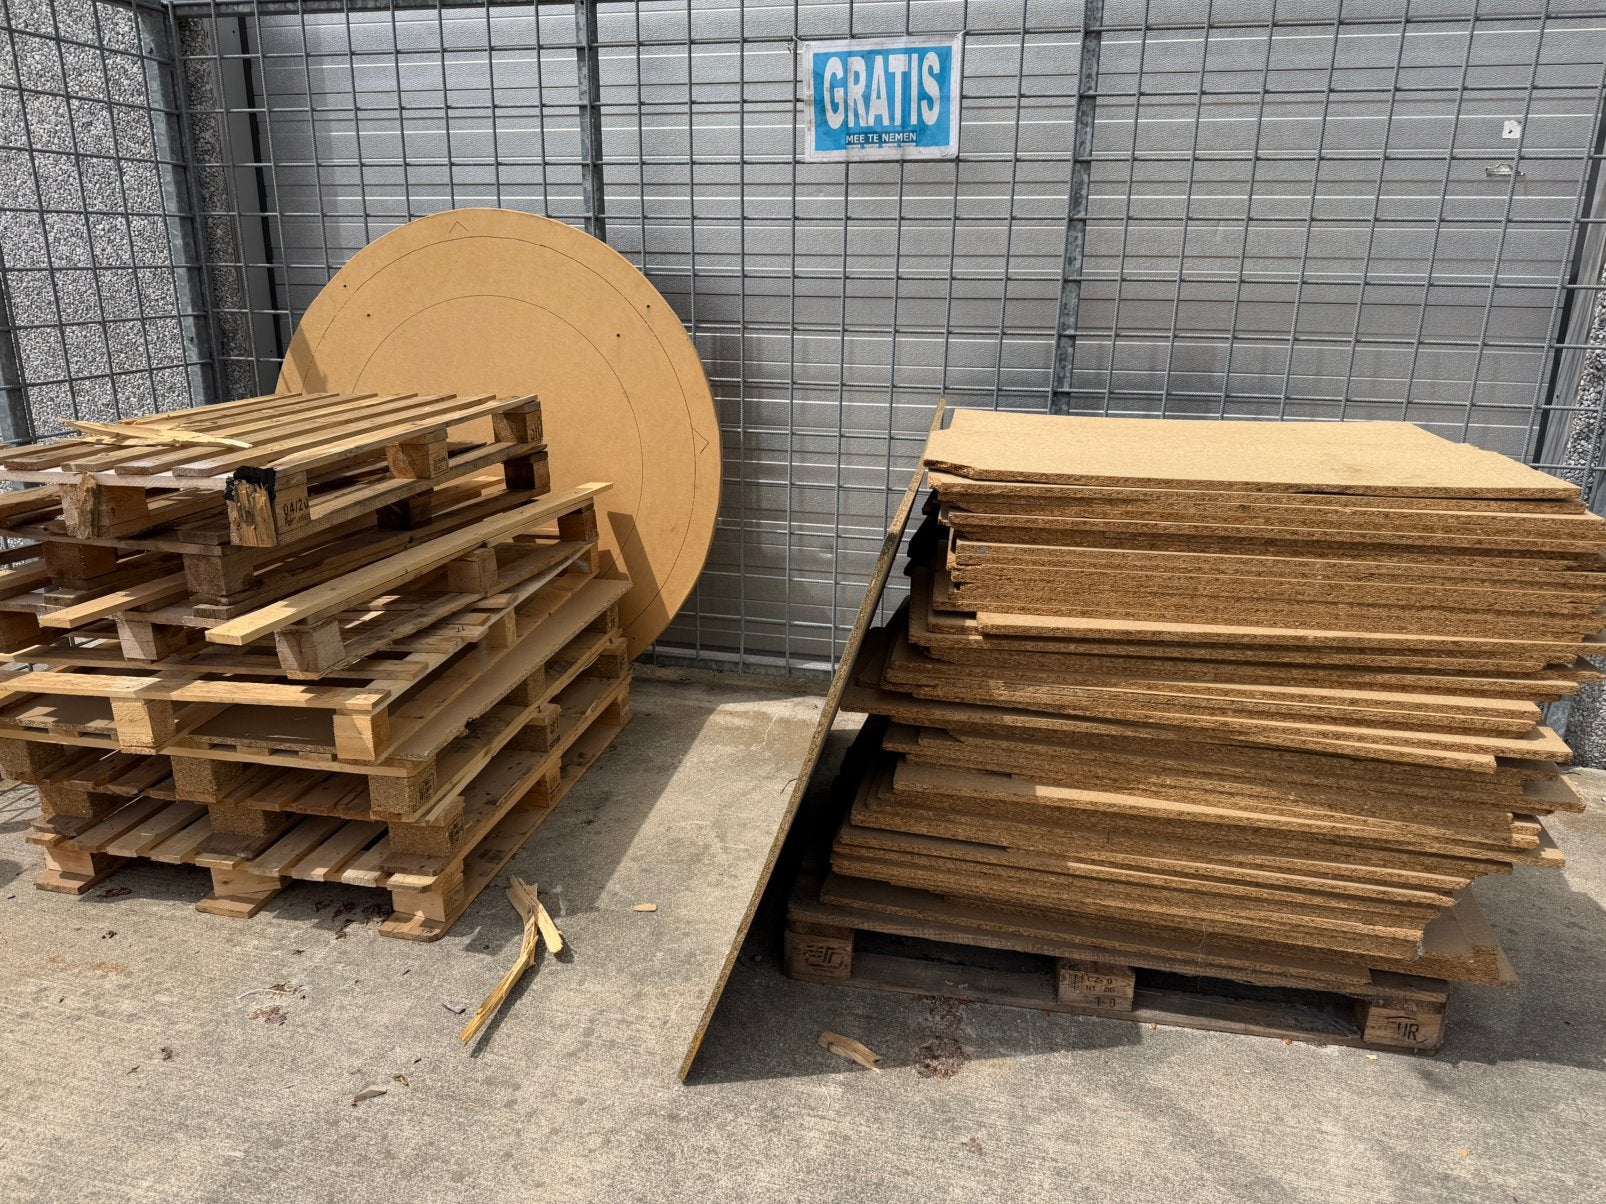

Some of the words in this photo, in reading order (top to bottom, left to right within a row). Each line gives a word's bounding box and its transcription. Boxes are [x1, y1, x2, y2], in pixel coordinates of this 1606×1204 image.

[823, 51, 941, 130] GRATIS
[846, 134, 865, 144] MEE
[868, 133, 879, 143] TE
[882, 132, 917, 142] NEMEN
